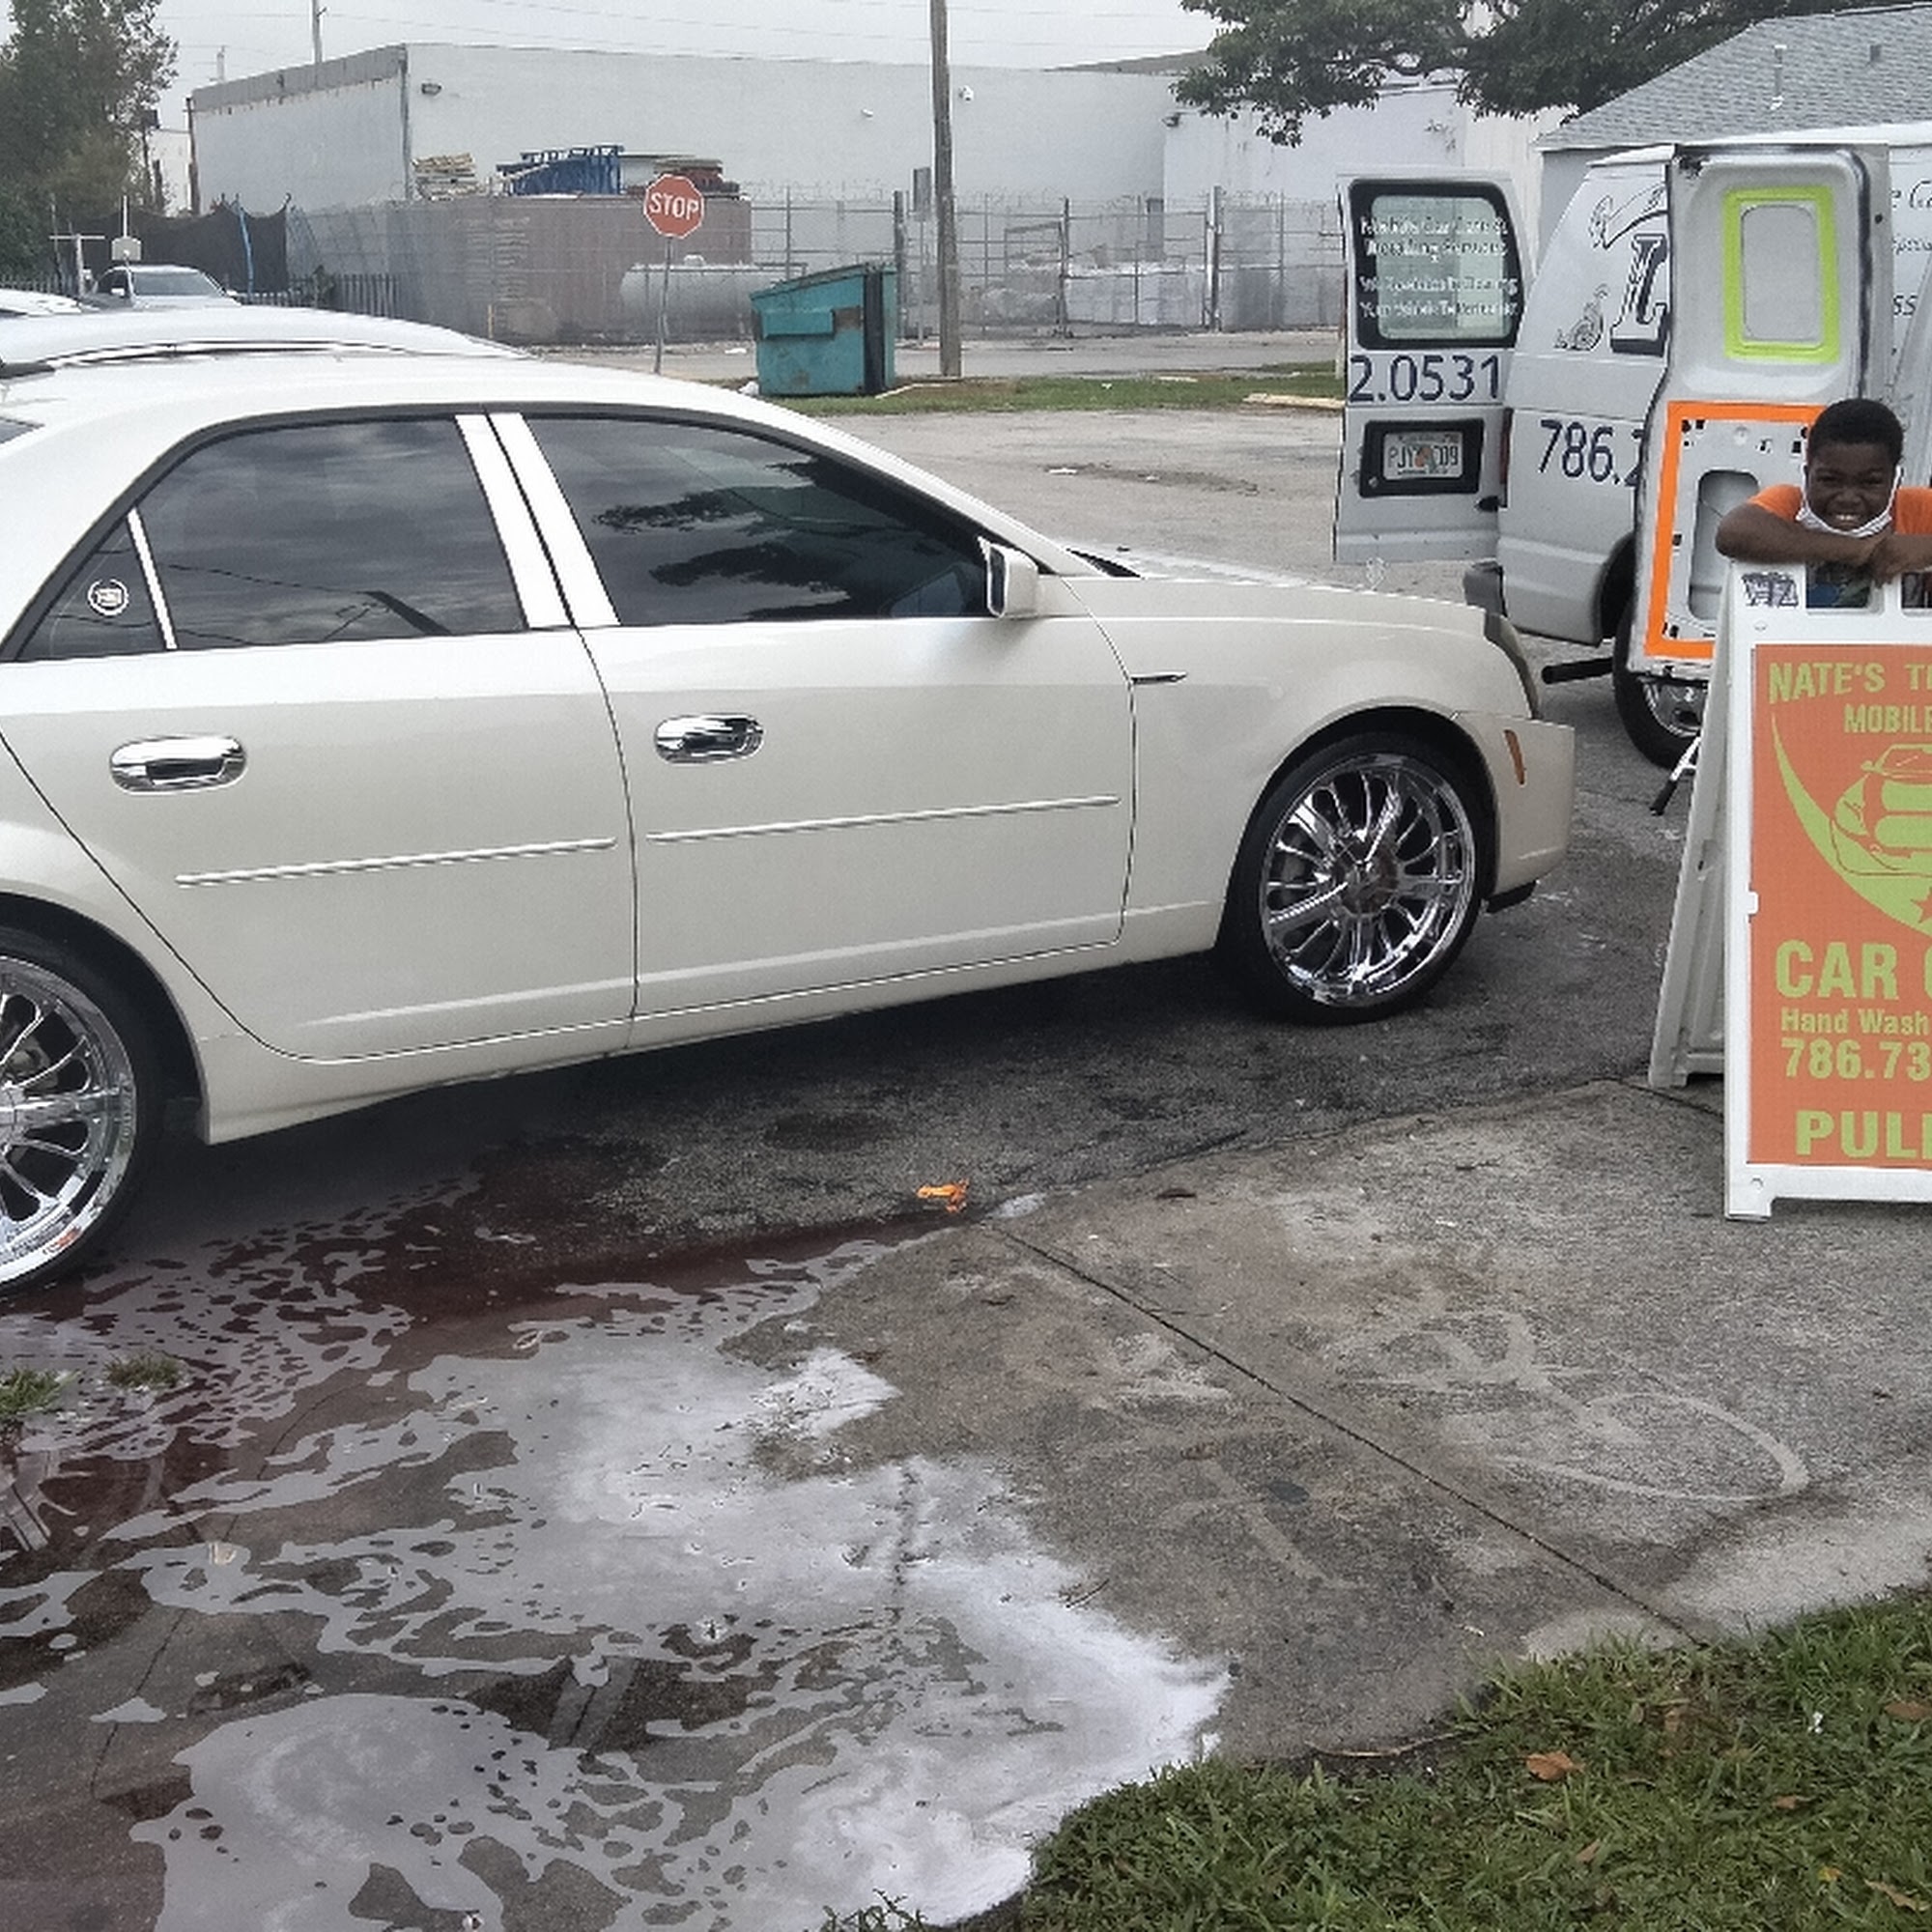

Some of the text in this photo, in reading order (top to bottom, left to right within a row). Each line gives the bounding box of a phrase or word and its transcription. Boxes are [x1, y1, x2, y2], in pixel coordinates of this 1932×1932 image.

[648, 192, 699, 220] STOP
[1350, 355, 1499, 402] 2.0531
[1769, 662, 1932, 705] NATE'S T
[1843, 703, 1932, 734] MOBILE
[1775, 939, 1899, 1001] CAR
[1781, 1008, 1929, 1037] Hand Wash
[1781, 1037, 1931, 1081] 786.73
